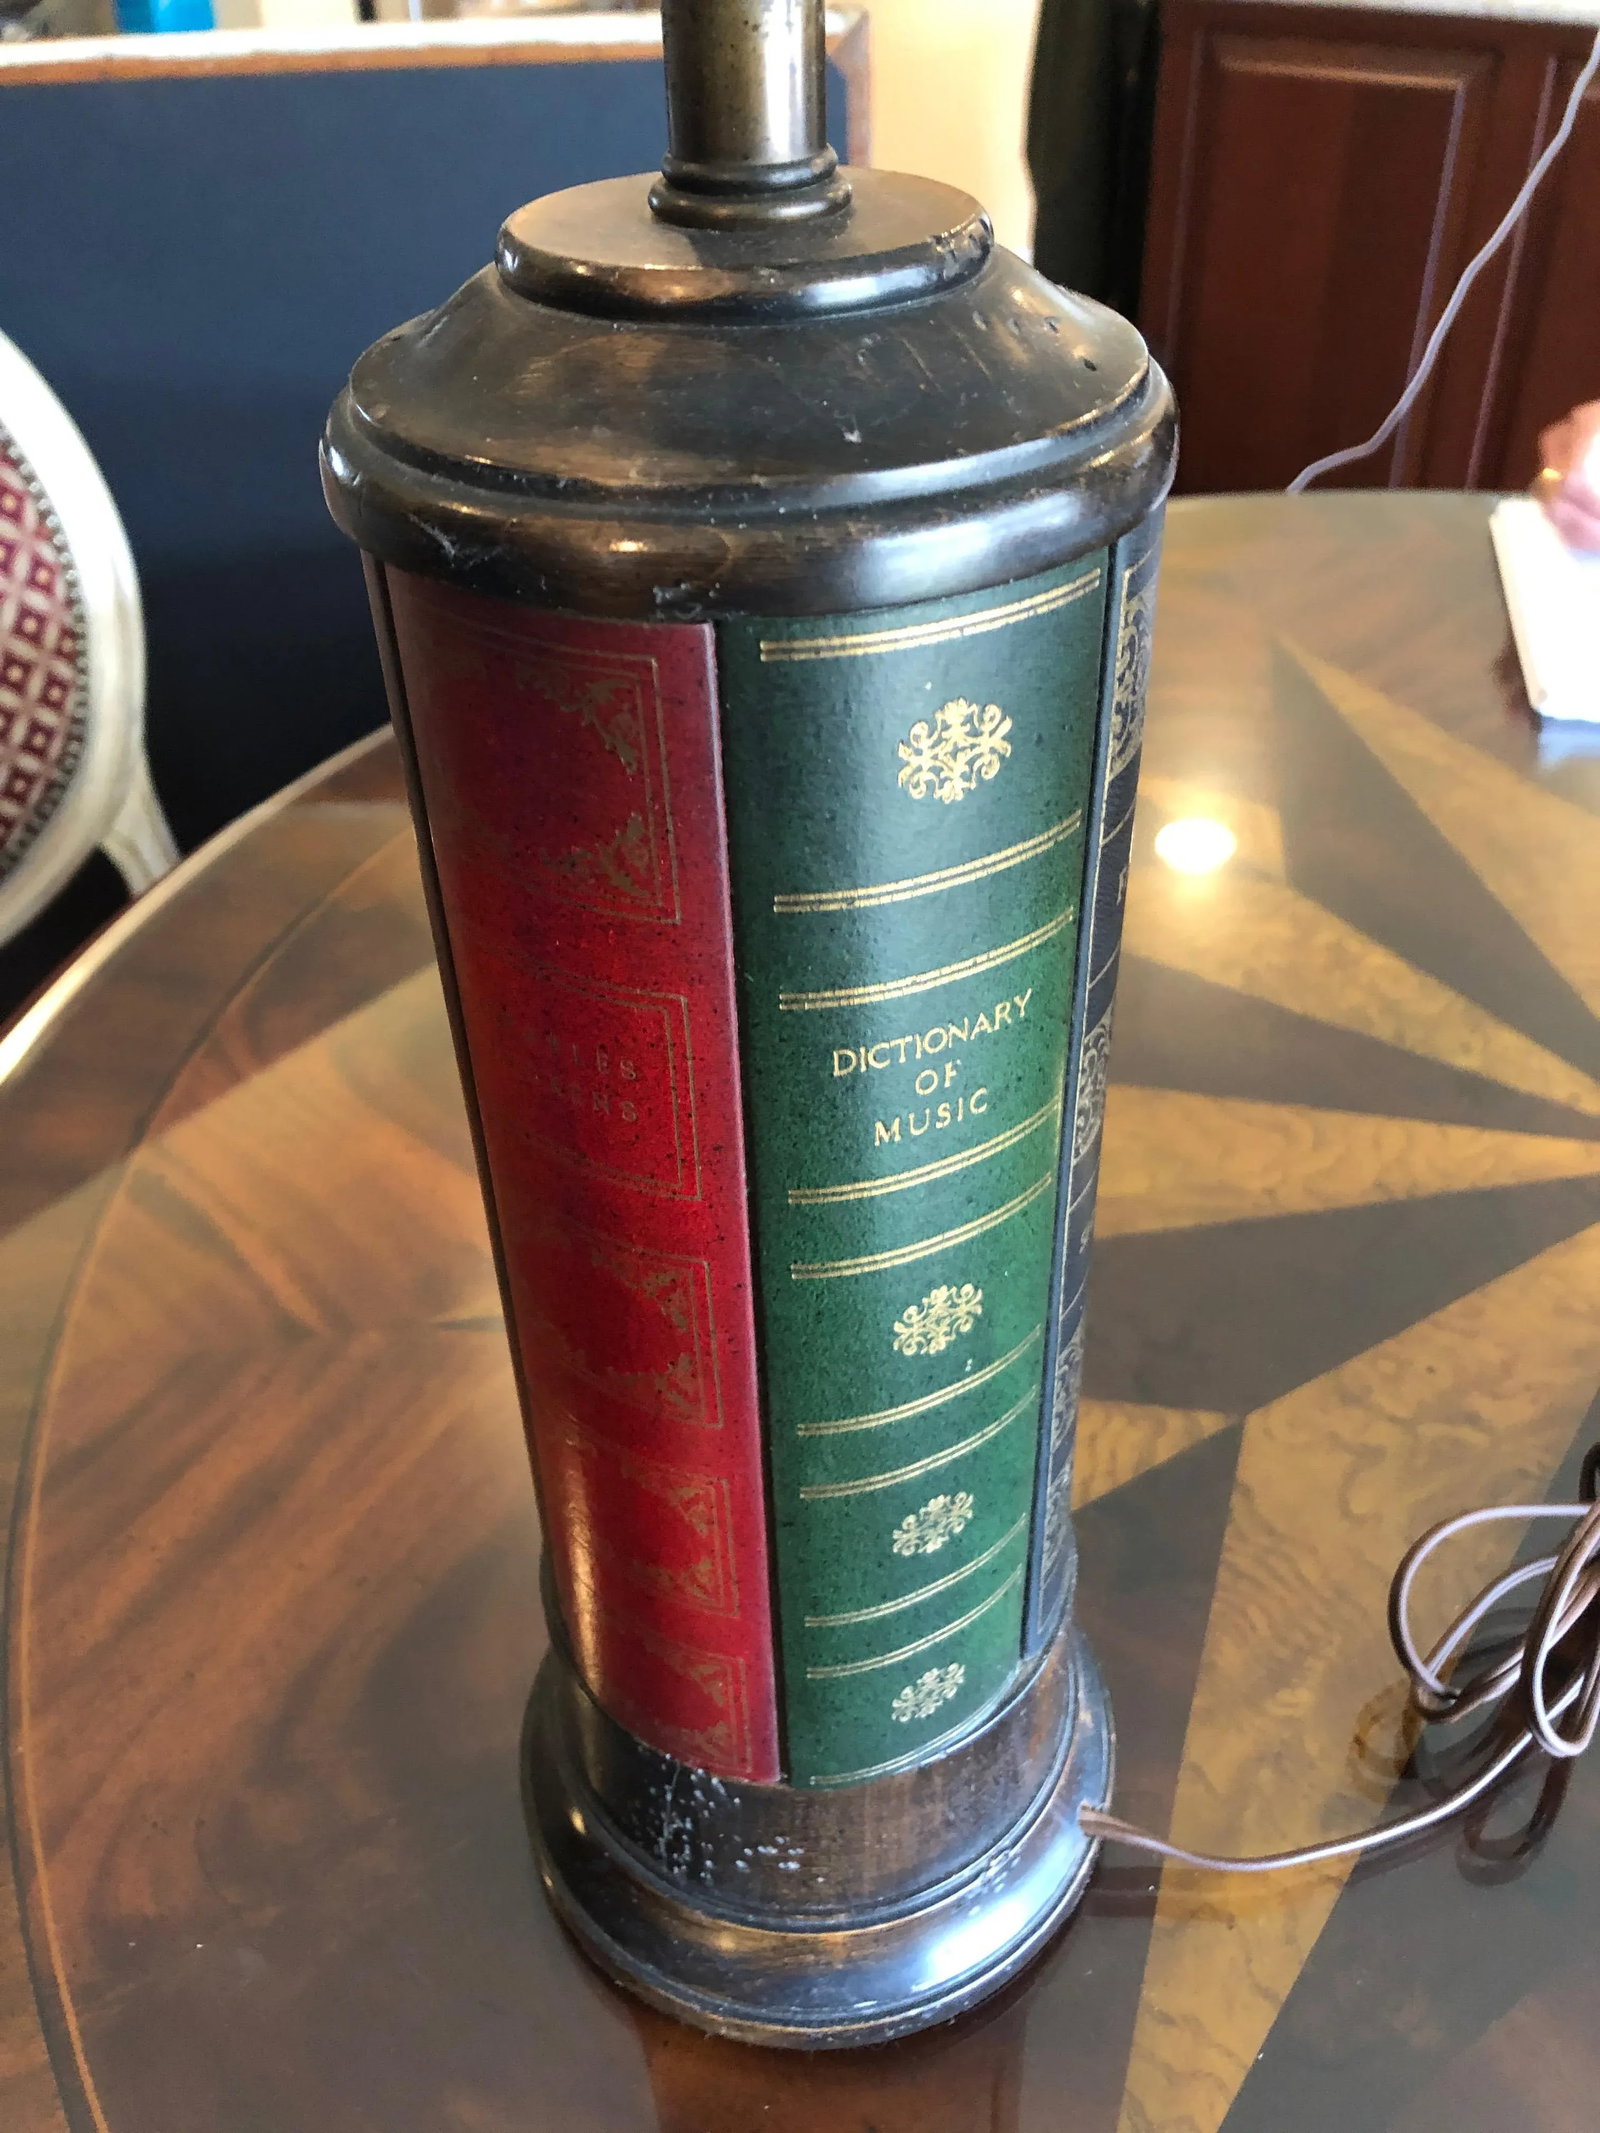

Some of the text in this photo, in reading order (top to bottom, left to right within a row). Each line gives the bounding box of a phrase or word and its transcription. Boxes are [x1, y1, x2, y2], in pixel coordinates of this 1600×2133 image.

[833, 988, 1032, 1077] DICTIONARY
[914, 1058, 962, 1095] OF
[874, 1087, 988, 1147] MUSIC
